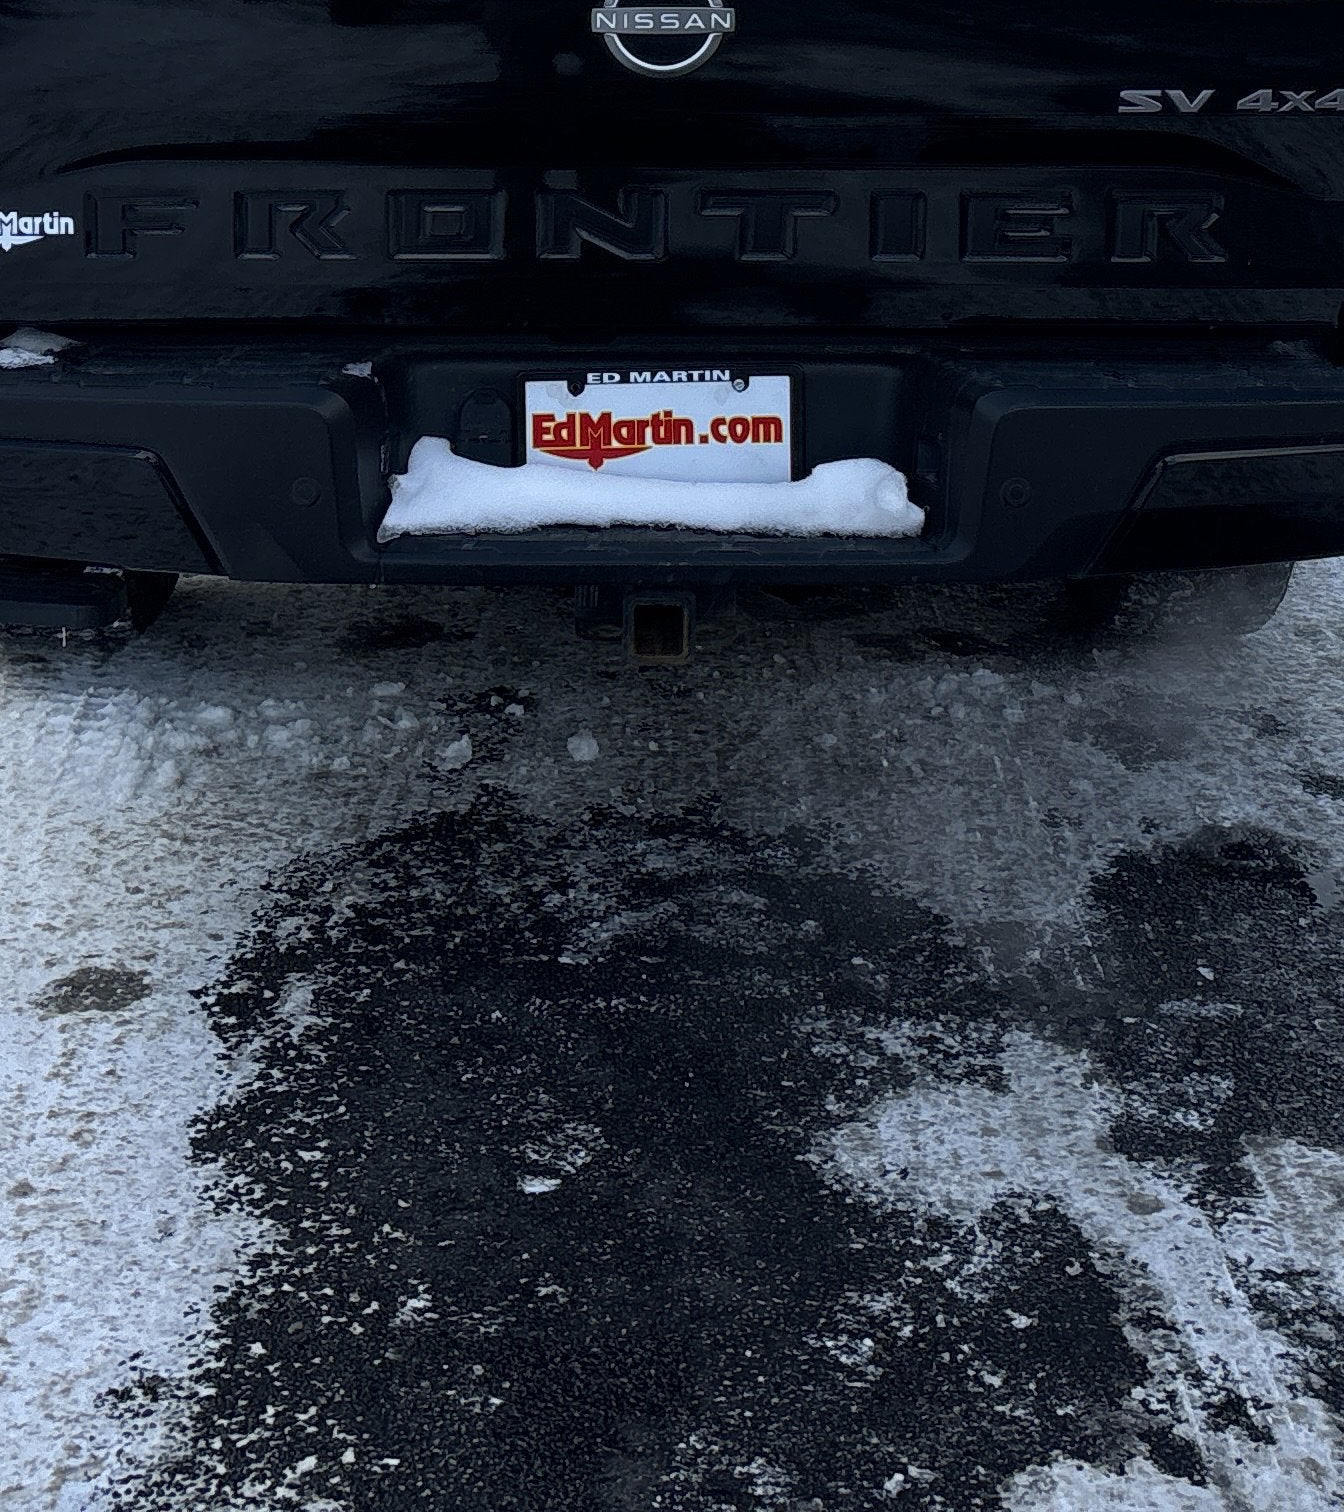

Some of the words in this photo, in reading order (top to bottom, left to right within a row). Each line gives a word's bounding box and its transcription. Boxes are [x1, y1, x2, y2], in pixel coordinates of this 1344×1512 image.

[596, 12, 731, 29] NISSAN
[1118, 89, 1216, 114] SV
[82, 185, 1232, 263] FRONTIER
[587, 372, 617, 384] ED
[629, 369, 731, 383] MARTIN
